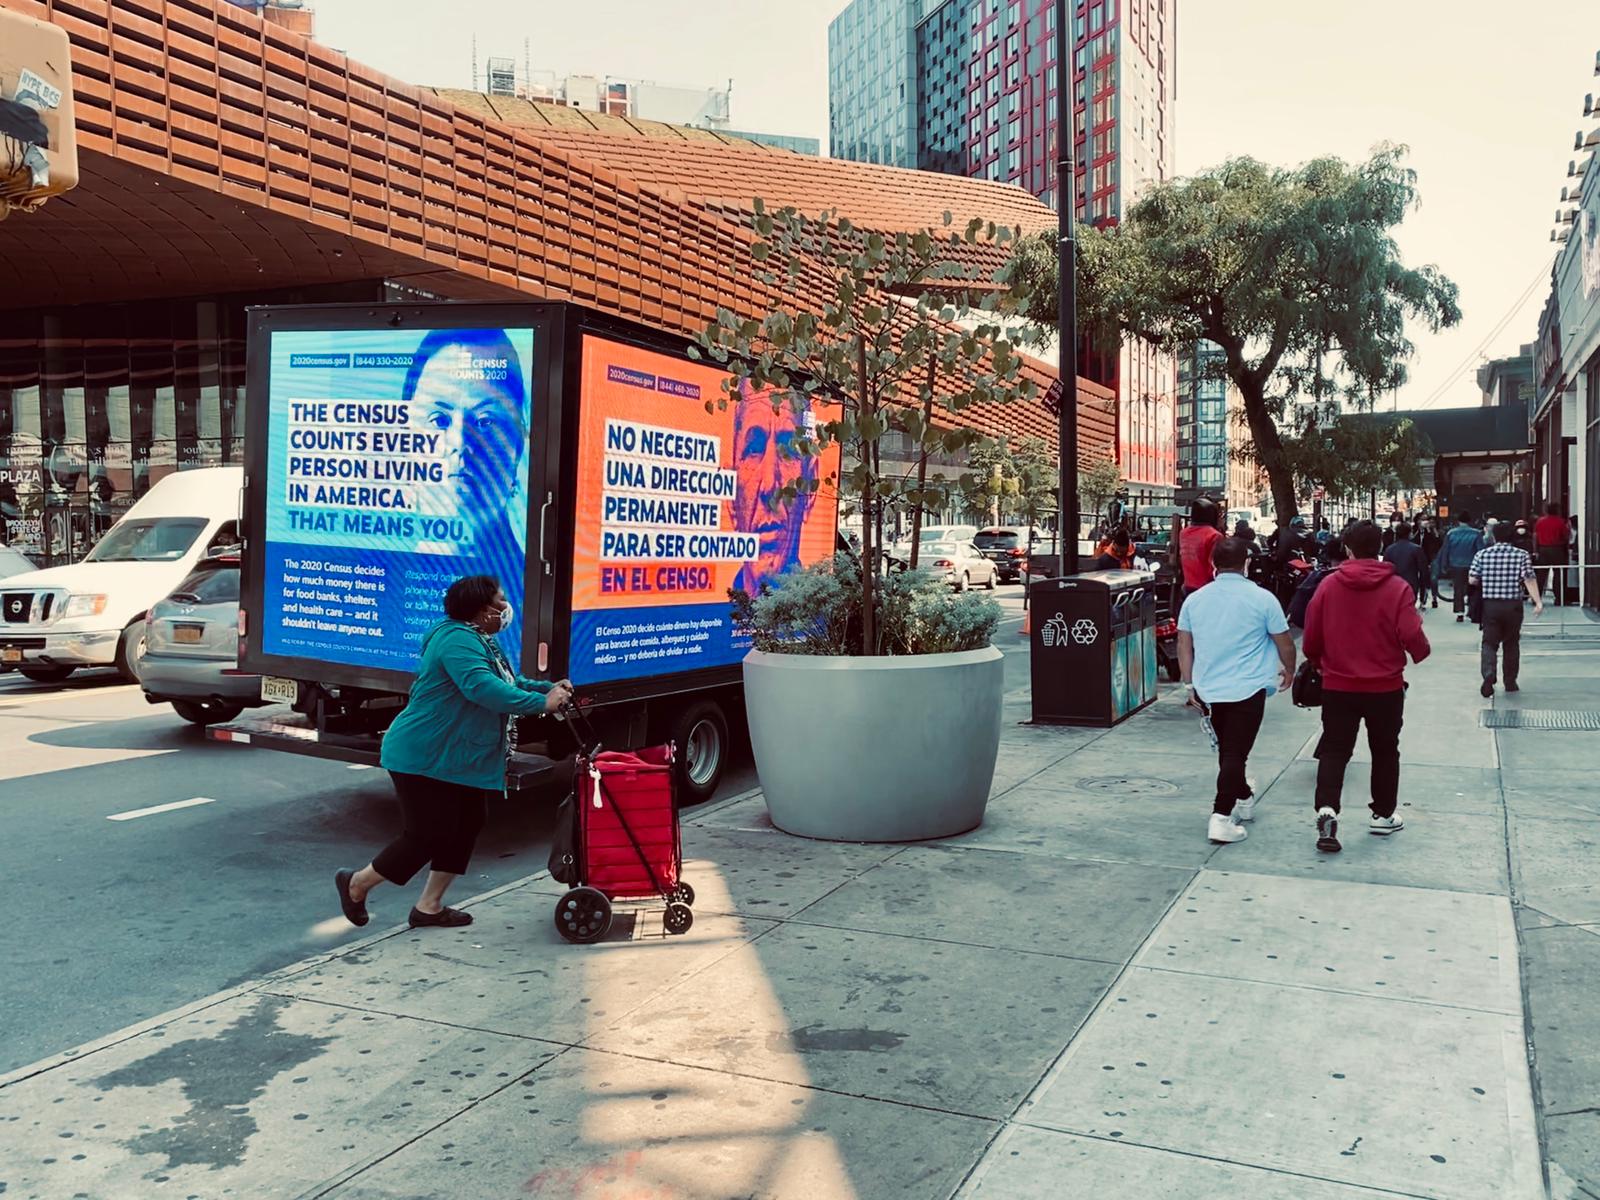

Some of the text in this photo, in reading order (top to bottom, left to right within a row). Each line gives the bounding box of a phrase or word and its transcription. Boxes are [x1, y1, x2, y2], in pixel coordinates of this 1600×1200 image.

[292, 356, 413, 367] 2020census.gov (844) 330-2020
[472, 359, 508, 369] CENSUS
[486, 370, 507, 380] 2020
[291, 403, 409, 425] THE CENSUS
[290, 430, 440, 454] COUNTS EVERY
[607, 424, 717, 463] NO NECESITA
[0, 469, 41, 483] PLAZA
[289, 457, 443, 482] PERSON LIVING
[606, 460, 734, 496] UNA DIRECCIÓN
[288, 483, 413, 509] IN AMERICA.
[604, 496, 718, 526] PERMANENTE
[288, 510, 469, 542] THAT MEANS YOU.
[603, 532, 756, 559] PARA SER CONTADO
[283, 558, 386, 577] The 2020 Census decides
[283, 573, 386, 592] how much money there is
[601, 566, 712, 592] EN EL CENSO.
[282, 587, 378, 607] for food banks, shelters,
[282, 603, 298, 613] and
[298, 603, 324, 616] health
[325, 608, 343, 618] care
[354, 610, 371, 621] and
[372, 611, 379, 621] it
[281, 616, 317, 629] shouldn't
[317, 620, 337, 632] leave
[338, 624, 367, 636] anyone
[595, 627, 603, 637] El
[602, 627, 621, 637] Censo
[622, 624, 637, 635] 2020
[637, 623, 655, 633] decide
[595, 642, 609, 653] para
[610, 638, 630, 650] bancos
[630, 638, 639, 647] de
[661, 635, 685, 646] albergues
[690, 632, 710, 642] cuidado
[628, 653, 637, 661] no
